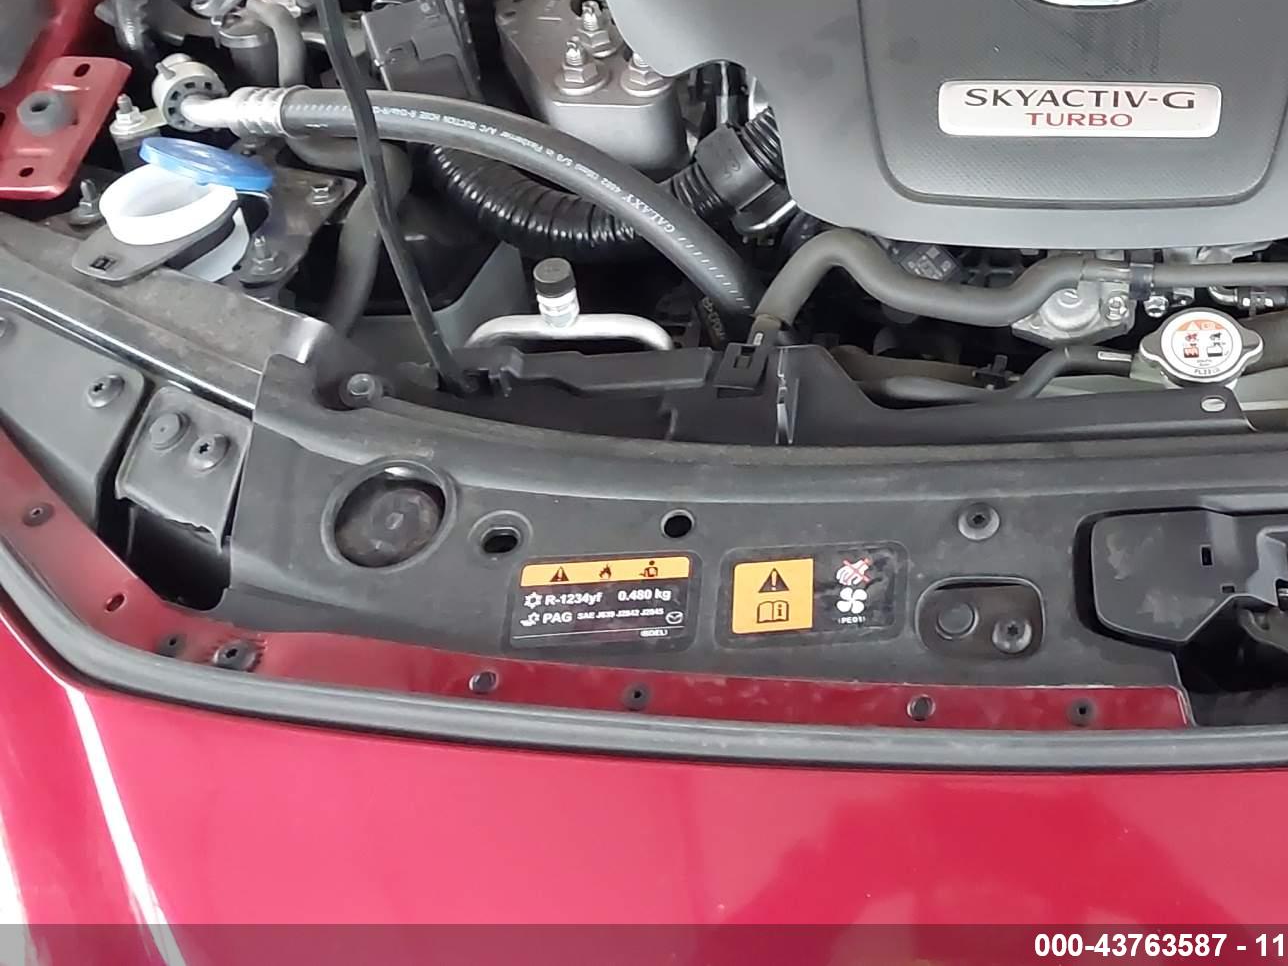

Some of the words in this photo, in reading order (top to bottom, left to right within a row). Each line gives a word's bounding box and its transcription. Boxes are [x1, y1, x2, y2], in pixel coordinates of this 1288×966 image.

[964, 88, 1196, 109] SKYACTIV-G
[1026, 112, 1133, 127] TURBO
[621, 194, 676, 233] GALAXY
[544, 592, 603, 606] R-1234yf
[617, 589, 652, 602] 0.480
[654, 588, 672, 601] kg
[542, 612, 573, 624] PAG
[577, 612, 595, 620] SAE
